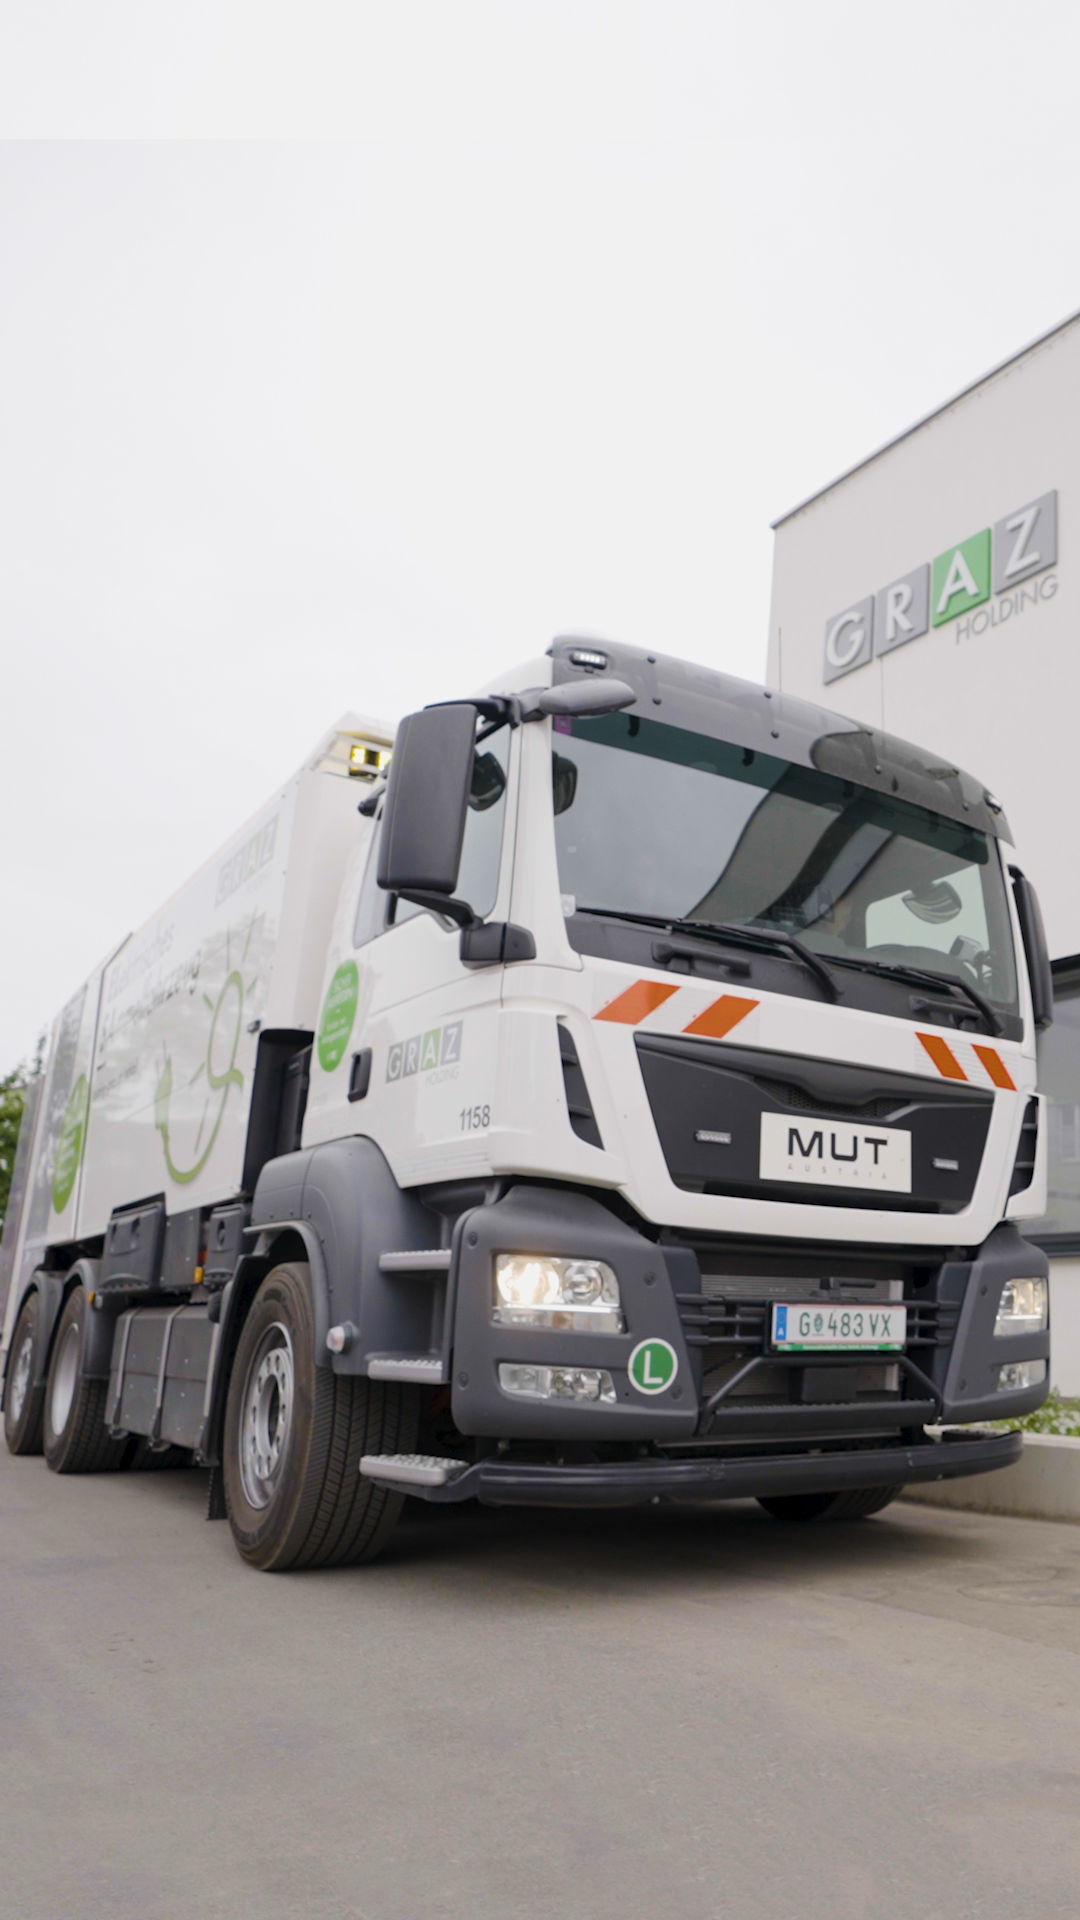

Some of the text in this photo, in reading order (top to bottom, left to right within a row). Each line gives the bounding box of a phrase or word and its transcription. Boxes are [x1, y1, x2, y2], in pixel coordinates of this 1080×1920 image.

[825, 504, 1042, 669] GRAZ
[955, 573, 1059, 646] HOLDING
[387, 1027, 458, 1080] GRAZ
[425, 1066, 460, 1086] HOLDING
[459, 1105, 491, 1131] 1158
[787, 1127, 888, 1165] MUT
[787, 1163, 888, 1180] AUSTRIA
[777, 1327, 785, 1337] A
[799, 1312, 892, 1337] G 483 VX
[643, 1350, 664, 1385] L
